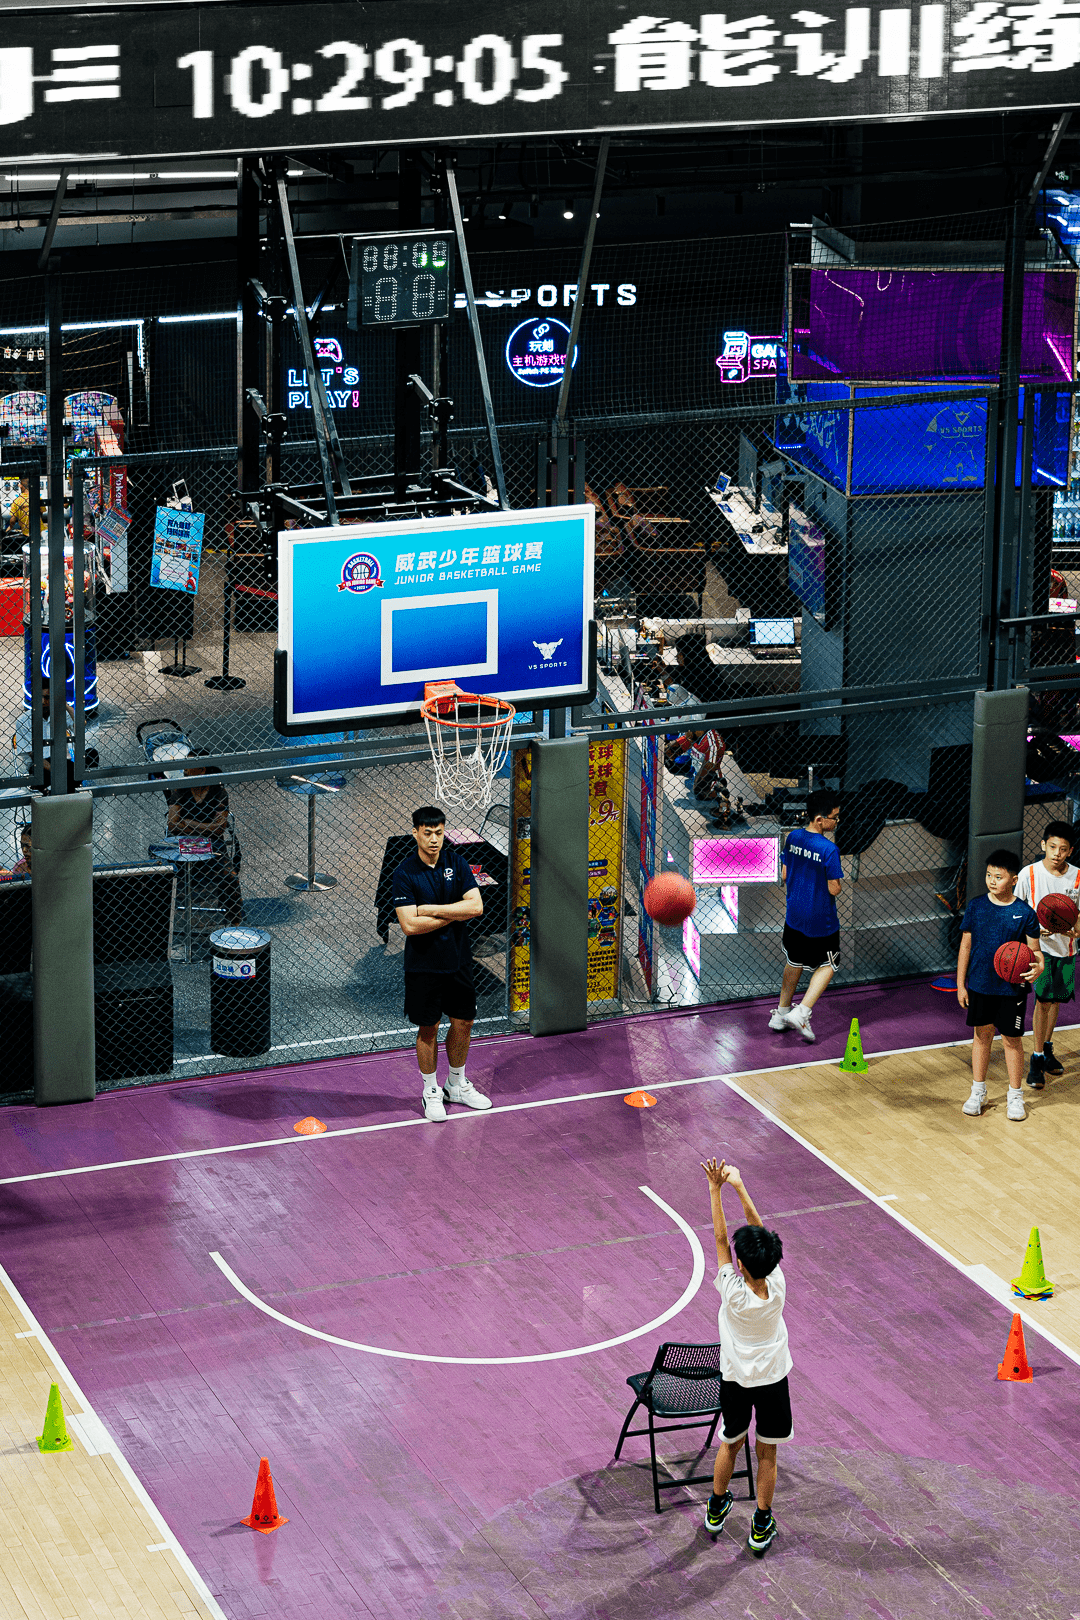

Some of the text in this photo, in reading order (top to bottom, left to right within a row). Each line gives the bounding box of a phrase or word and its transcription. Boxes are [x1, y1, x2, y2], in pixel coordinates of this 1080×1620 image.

[177, 34, 570, 119] 10:29:05
[395, 541, 544, 572] 威武少年篮球赛
[394, 563, 541, 585] JUNIOR BASKETBALL GAME
[540, 661, 568, 669] SPORTS
[789, 844, 822, 862] JUST DO IT.
